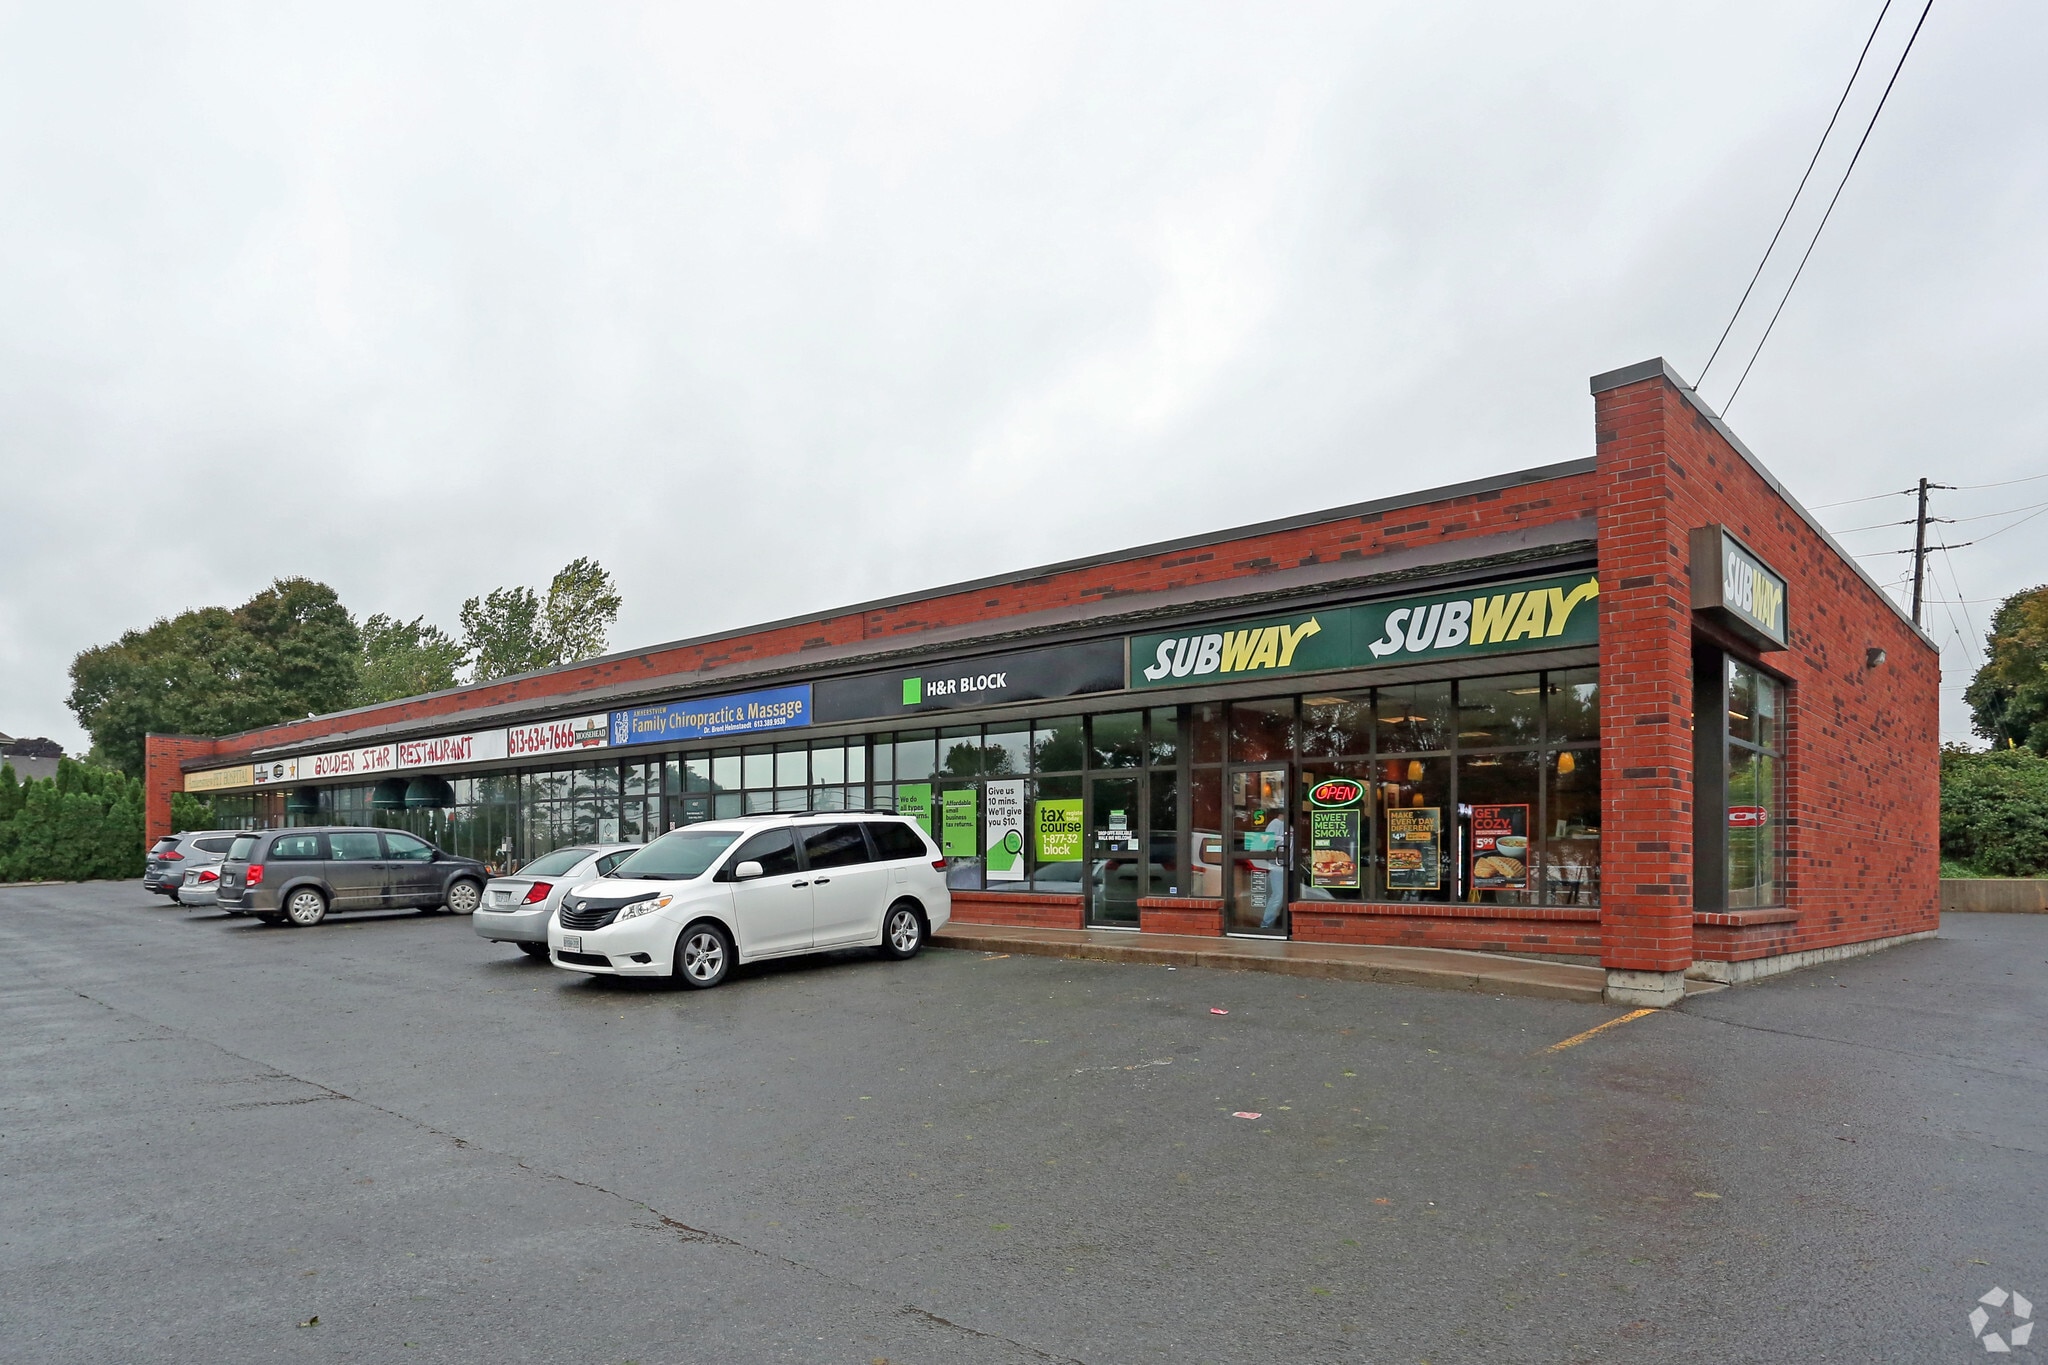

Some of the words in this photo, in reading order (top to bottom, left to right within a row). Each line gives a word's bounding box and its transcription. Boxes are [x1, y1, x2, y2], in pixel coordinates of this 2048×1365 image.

[1724, 551, 1783, 631] SUBWAY
[1368, 576, 1600, 659] SUBWAY
[1143, 616, 1322, 682] SUBWAY
[927, 679, 957, 697] H&R
[960, 672, 1007, 693] BLOCK
[633, 706, 668, 717] AMHERSTVIEW
[632, 717, 667, 735] Family
[669, 706, 735, 730] Chiropractic
[736, 706, 744, 721] &
[747, 700, 802, 720] Massage
[509, 722, 575, 755] 613-634-7666
[314, 753, 355, 775] GOLDEN
[362, 746, 390, 770] STAR
[399, 736, 473, 765] RESTAURANT
[988, 787, 1004, 795] Give
[1316, 785, 1357, 801] OPEN
[997, 797, 1018, 805] mins.
[988, 807, 1006, 816] We'll
[1006, 806, 1022, 817] give
[1041, 807, 1065, 822] tax
[1475, 808, 1500, 818] GET
[988, 819, 1002, 828] you
[1002, 817, 1018, 826] $10.
[1314, 813, 1348, 822] SWEET
[1391, 818, 1417, 826] EVERY
[1040, 823, 1082, 833] course
[1314, 821, 1346, 830] MEETS
[1475, 818, 1512, 829] COZY.
[1042, 834, 1078, 844] 1-877-32
[1314, 829, 1350, 838] SMOKY.
[1043, 844, 1070, 855] block
